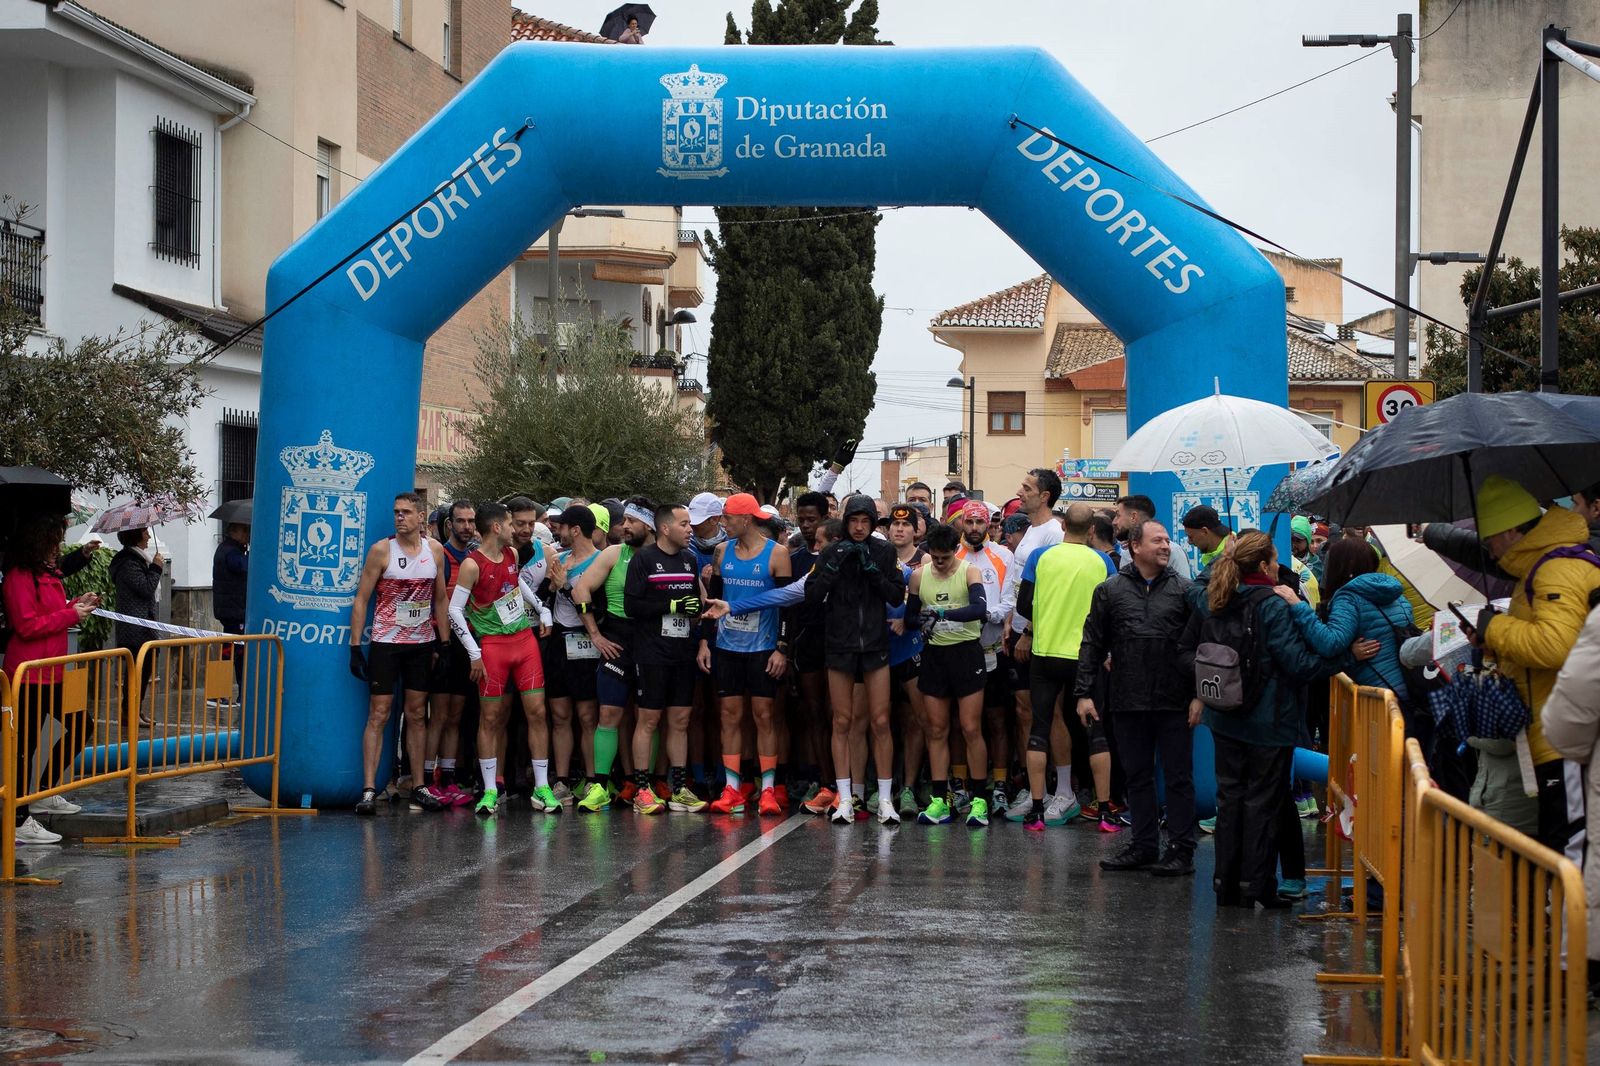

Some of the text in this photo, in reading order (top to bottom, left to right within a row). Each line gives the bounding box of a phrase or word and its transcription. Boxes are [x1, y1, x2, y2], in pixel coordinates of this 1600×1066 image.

[735, 96, 888, 127] Diputación
[735, 132, 888, 159] de Granada
[346, 127, 523, 302] DEPORTES
[1016, 126, 1206, 294] DEPORTES
[408, 609, 421, 618] 101
[261, 618, 375, 646] DEPORTS
[577, 640, 593, 650] 531
